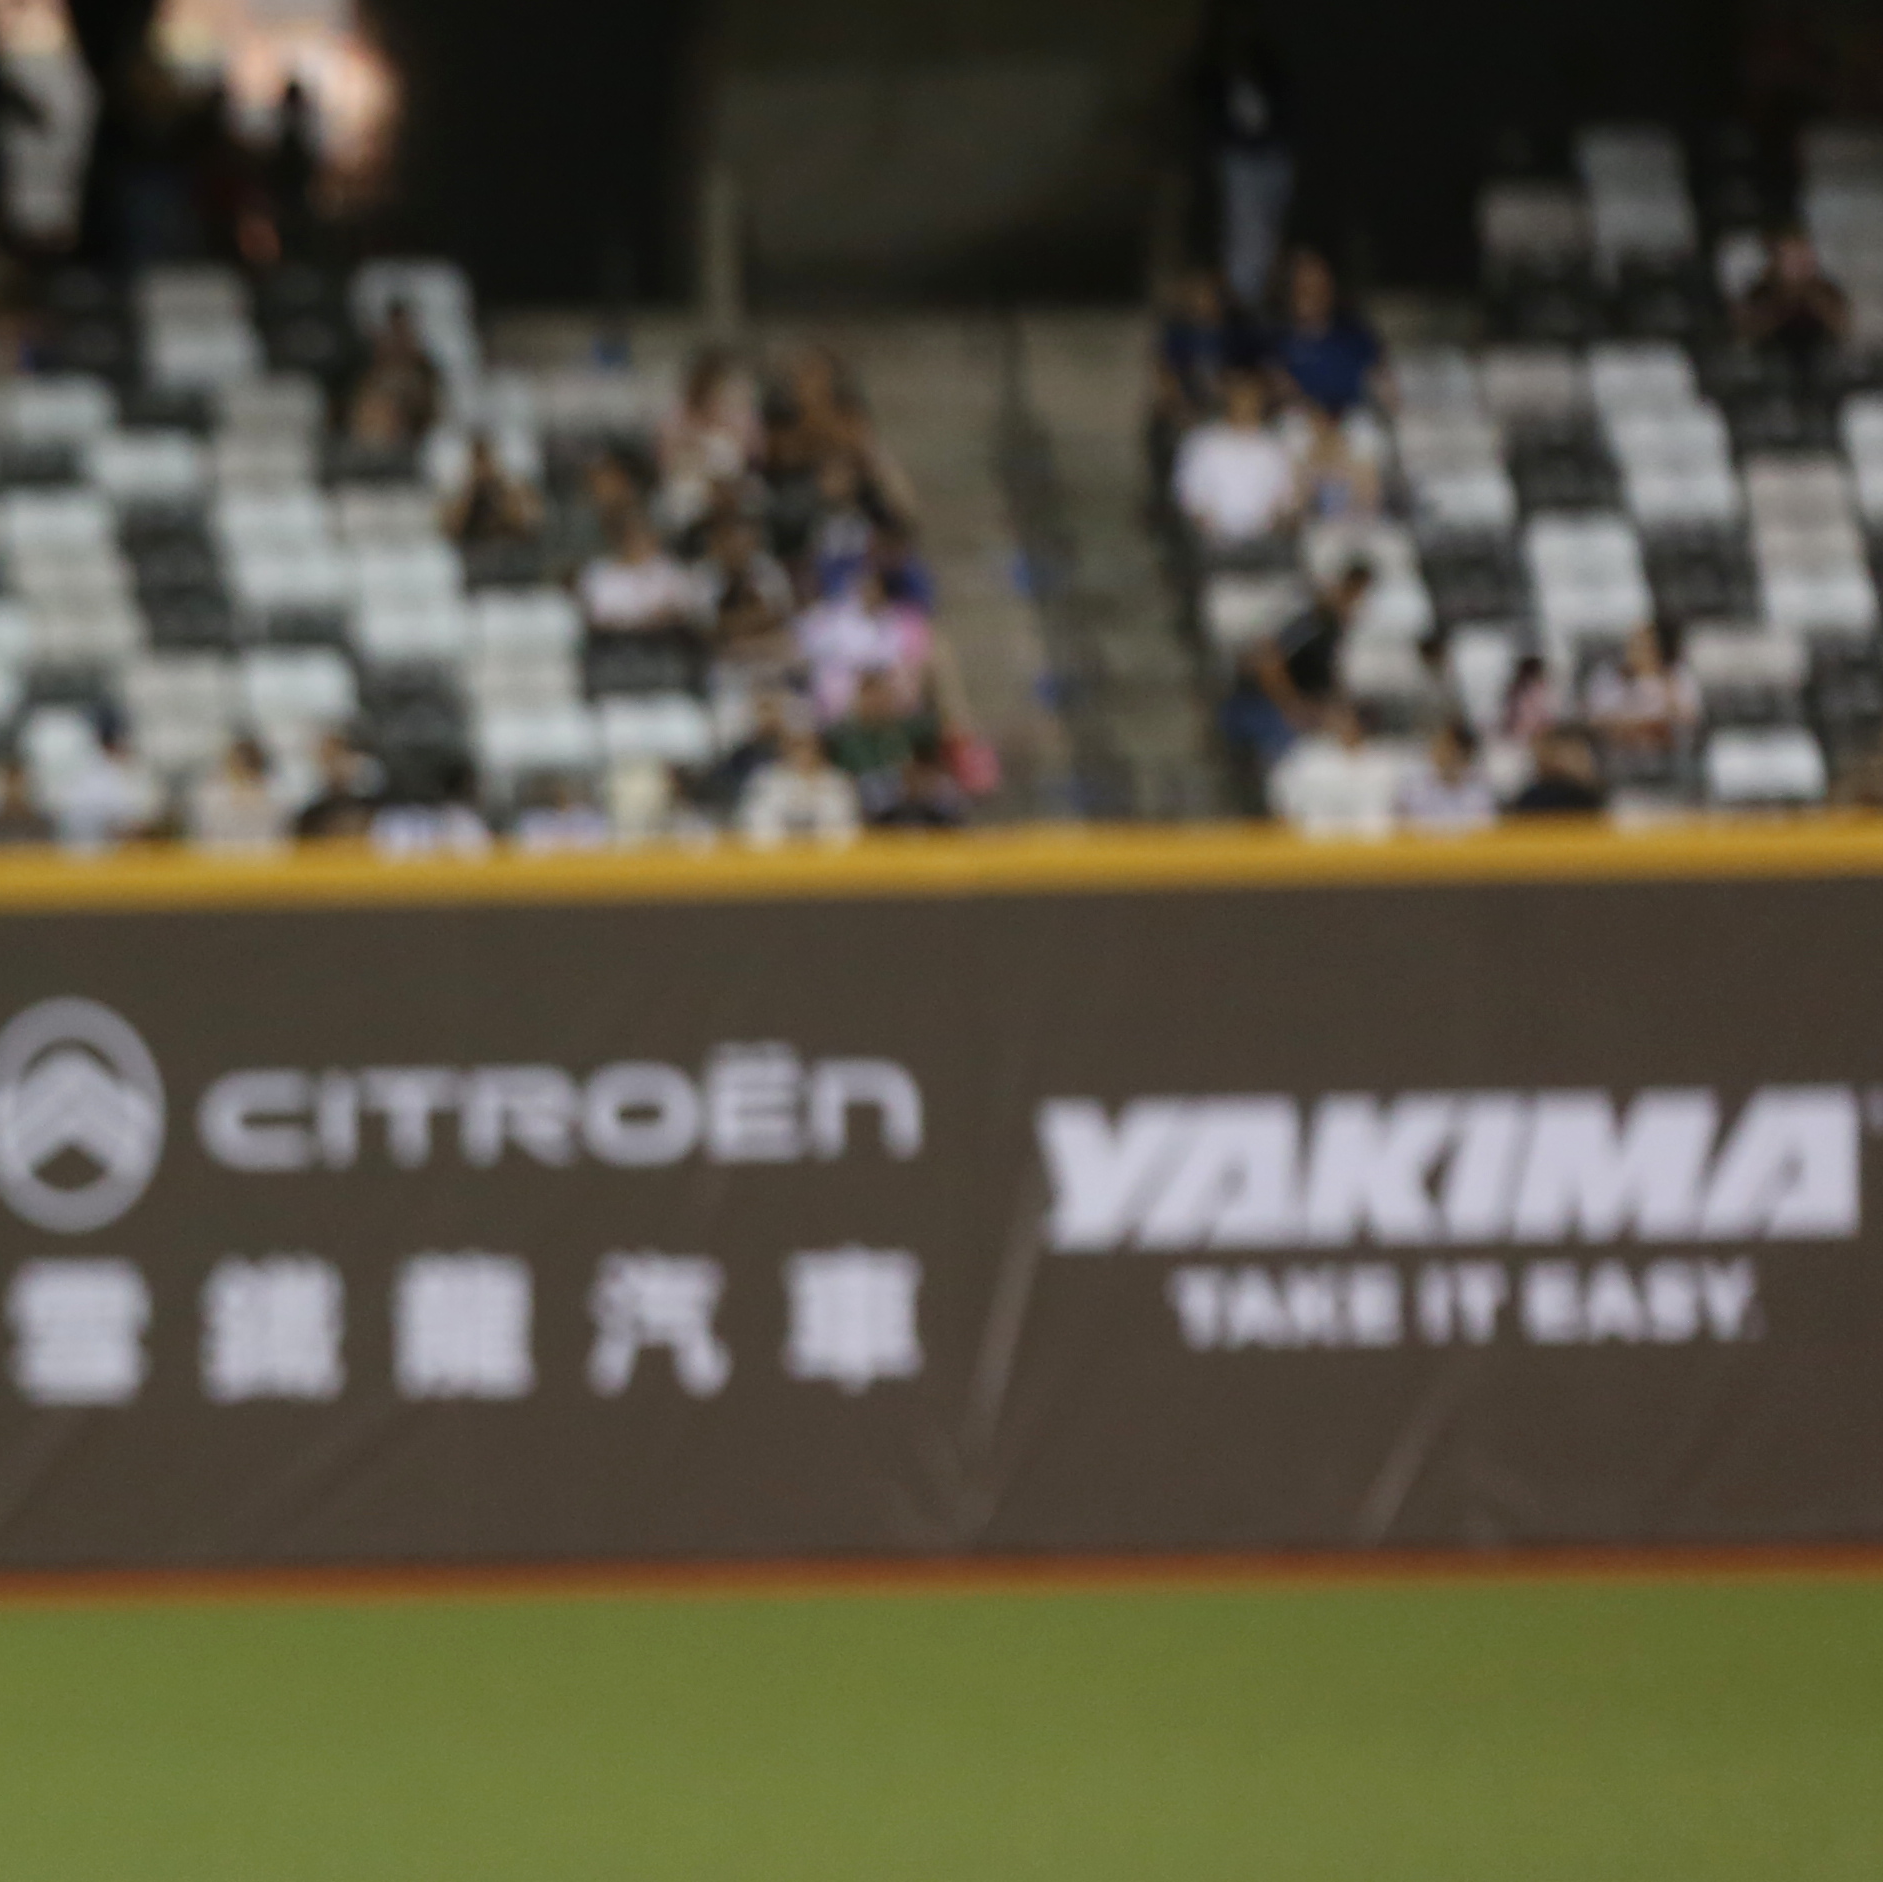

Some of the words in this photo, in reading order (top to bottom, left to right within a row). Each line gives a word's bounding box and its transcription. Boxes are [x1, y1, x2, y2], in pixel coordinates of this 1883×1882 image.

[1039, 1086, 1861, 1252] YAKIMA
[1169, 1264, 1403, 1348] TAKE
[1418, 1262, 1507, 1345] IT
